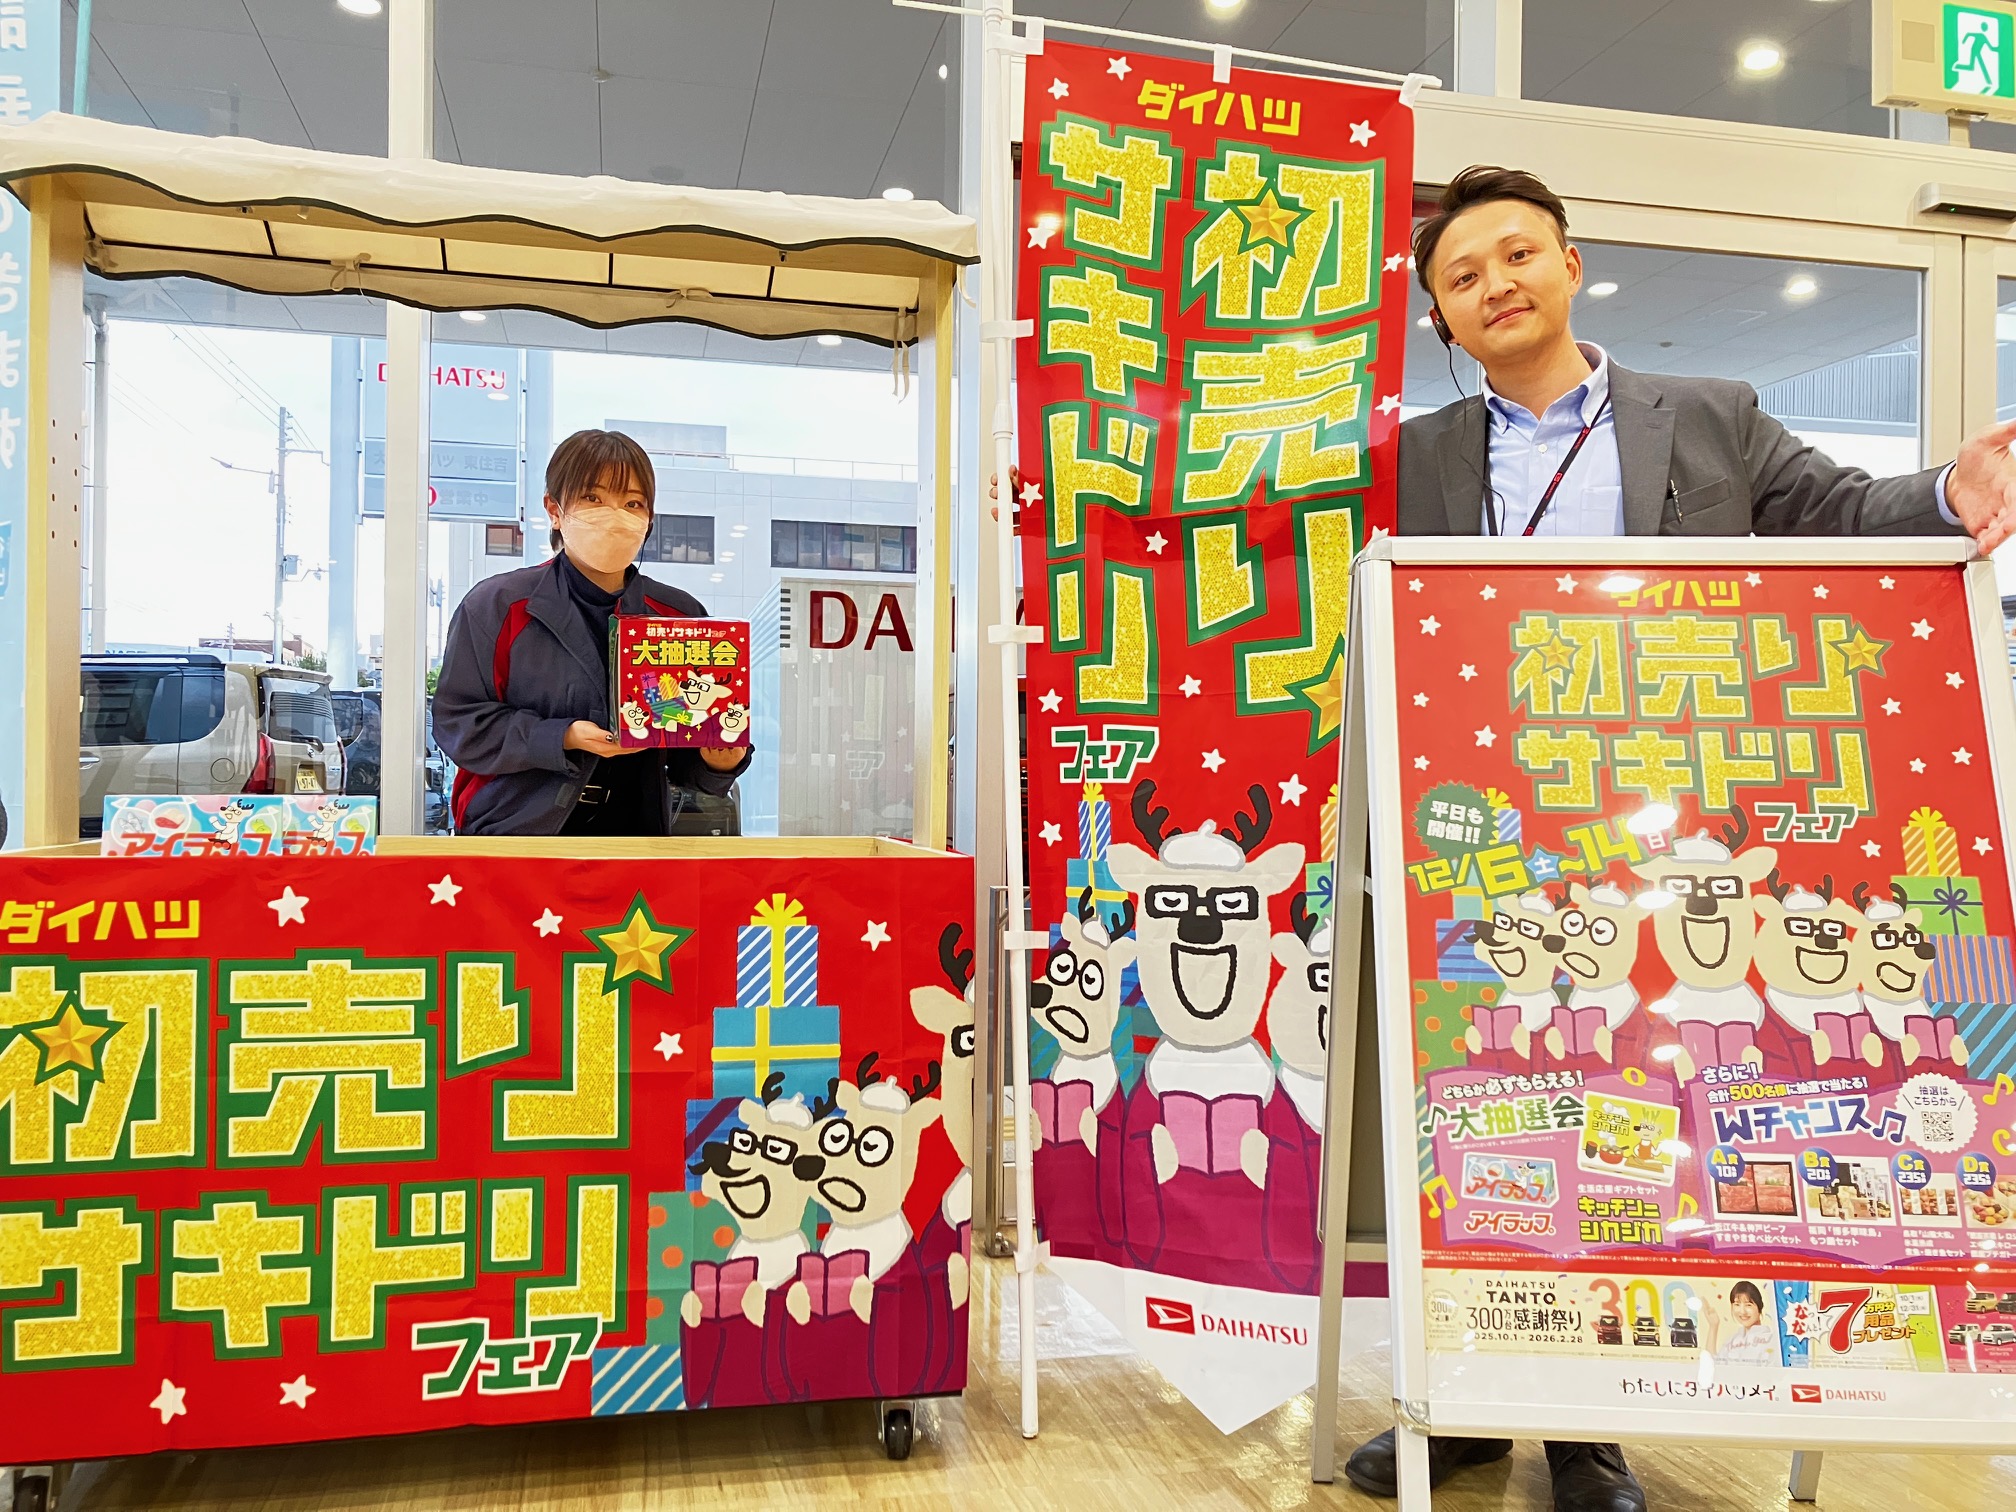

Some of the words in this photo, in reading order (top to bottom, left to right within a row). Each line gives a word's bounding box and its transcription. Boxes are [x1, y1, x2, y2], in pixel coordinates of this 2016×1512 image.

[1137, 79, 1302, 136] ダイハツ
[378, 363, 506, 390] DHATSU
[1047, 120, 1174, 705] サキドリ
[632, 640, 739, 666] 大抽選会
[1514, 615, 1857, 718] 初売り
[1051, 723, 1160, 784] フェア
[1516, 729, 1870, 813] サキドリ
[1430, 800, 1484, 824] 平日も
[1753, 804, 1860, 844] フェア
[0, 899, 200, 944] ダイハツ
[1913, 1095, 1957, 1107] こちらから
[1918, 1085, 1949, 1096] 抽選は
[1450, 1094, 1585, 1140] 大抽選会
[1713, 1097, 1873, 1143] Wチャンス
[0, 1183, 616, 1362] サキドリ
[1486, 1280, 1556, 1290] DAIHATSU
[1486, 1291, 1557, 1305] TANTO
[1864, 1301, 1896, 1314] 万円分
[1201, 1314, 1310, 1347] DAIHATSU
[1819, 1287, 1872, 1353] 7
[1853, 1325, 1917, 1344] プレゼント
[1864, 1313, 1896, 1329] 用品
[1474, 1334, 1518, 1342] 025.10.1
[1529, 1334, 1583, 1344] 2026.2.28
[411, 1315, 604, 1401] フェア
[1825, 1389, 1887, 1402] DAIHATSU
